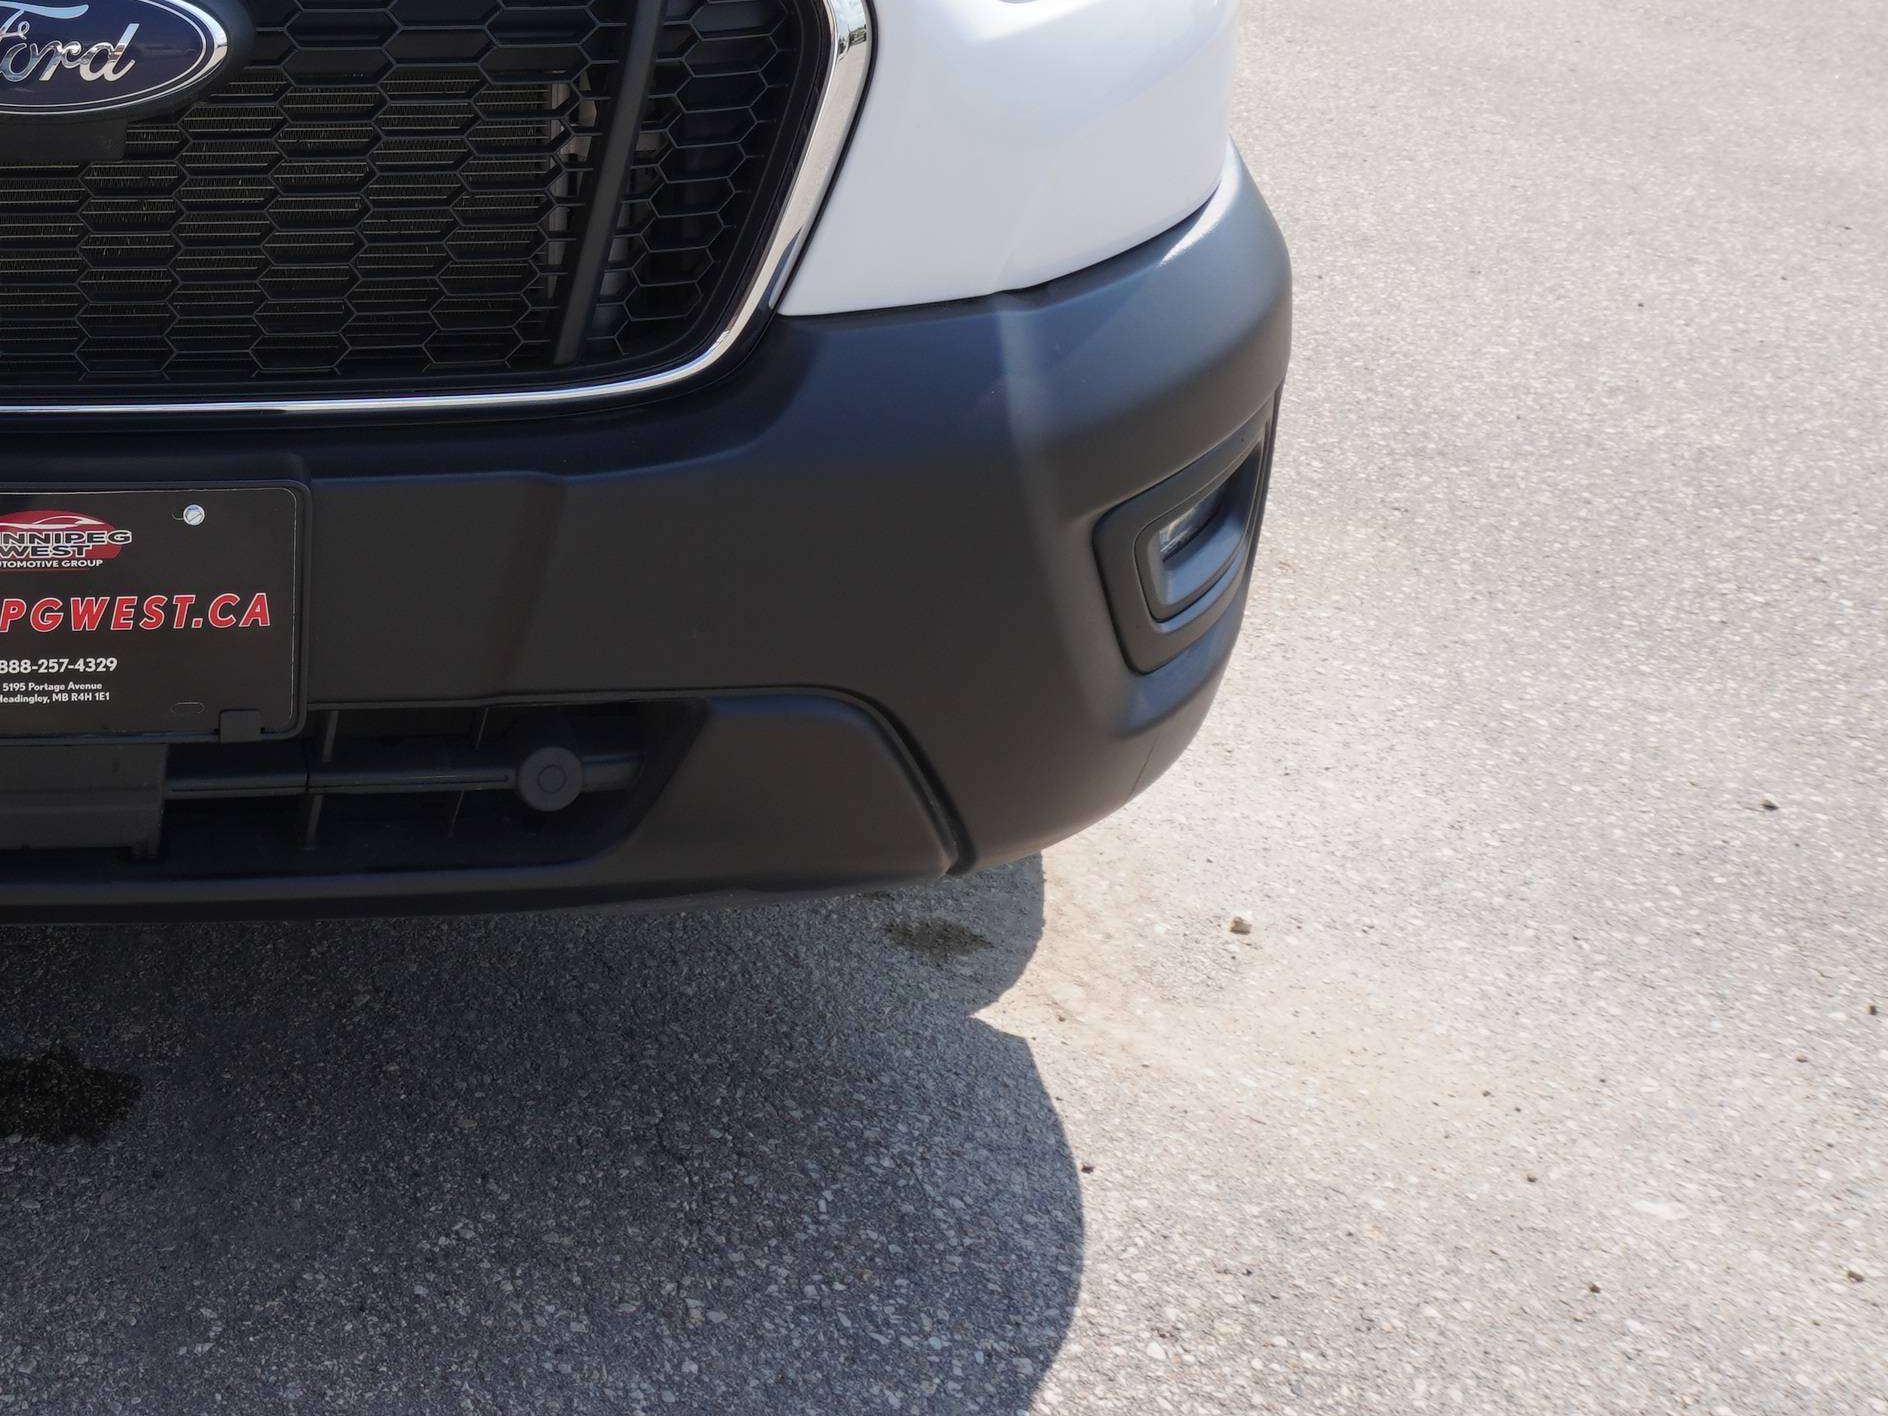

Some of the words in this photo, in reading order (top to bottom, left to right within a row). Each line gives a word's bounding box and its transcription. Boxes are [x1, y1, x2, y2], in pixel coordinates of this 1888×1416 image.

[62, 559, 103, 568] GROUP
[2, 682, 26, 692] 5195
[28, 682, 65, 692] Portage
[67, 681, 103, 690] Avenue
[52, 692, 69, 702] MB
[71, 692, 92, 701] R4H
[94, 691, 110, 701] 1E1
